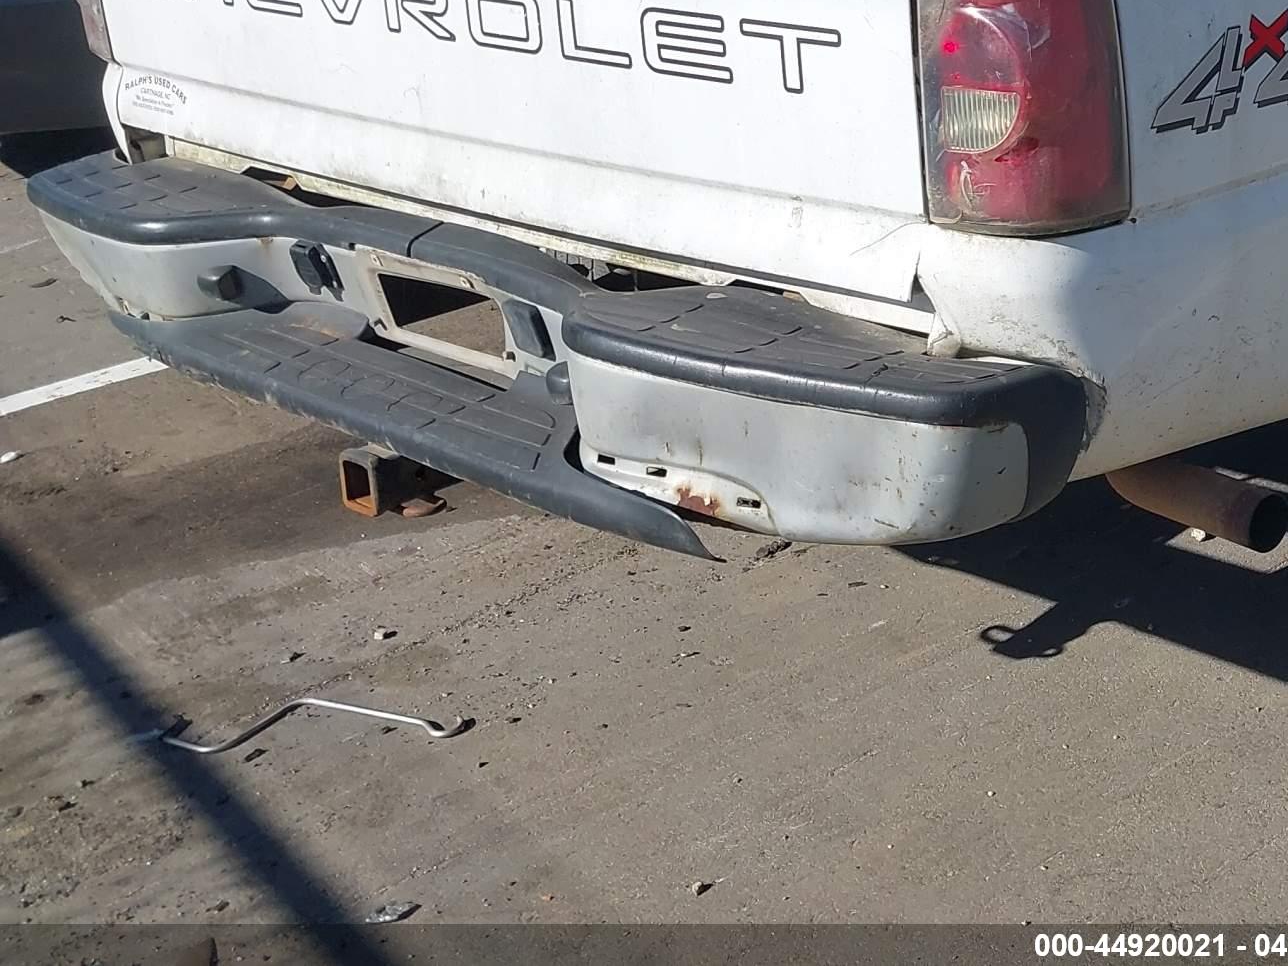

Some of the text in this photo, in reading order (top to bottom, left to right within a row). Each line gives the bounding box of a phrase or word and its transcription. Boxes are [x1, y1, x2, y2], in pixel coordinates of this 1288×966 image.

[125, 75, 153, 91] RALPH'S
[154, 77, 171, 90] USED
[171, 84, 187, 105] CARS
